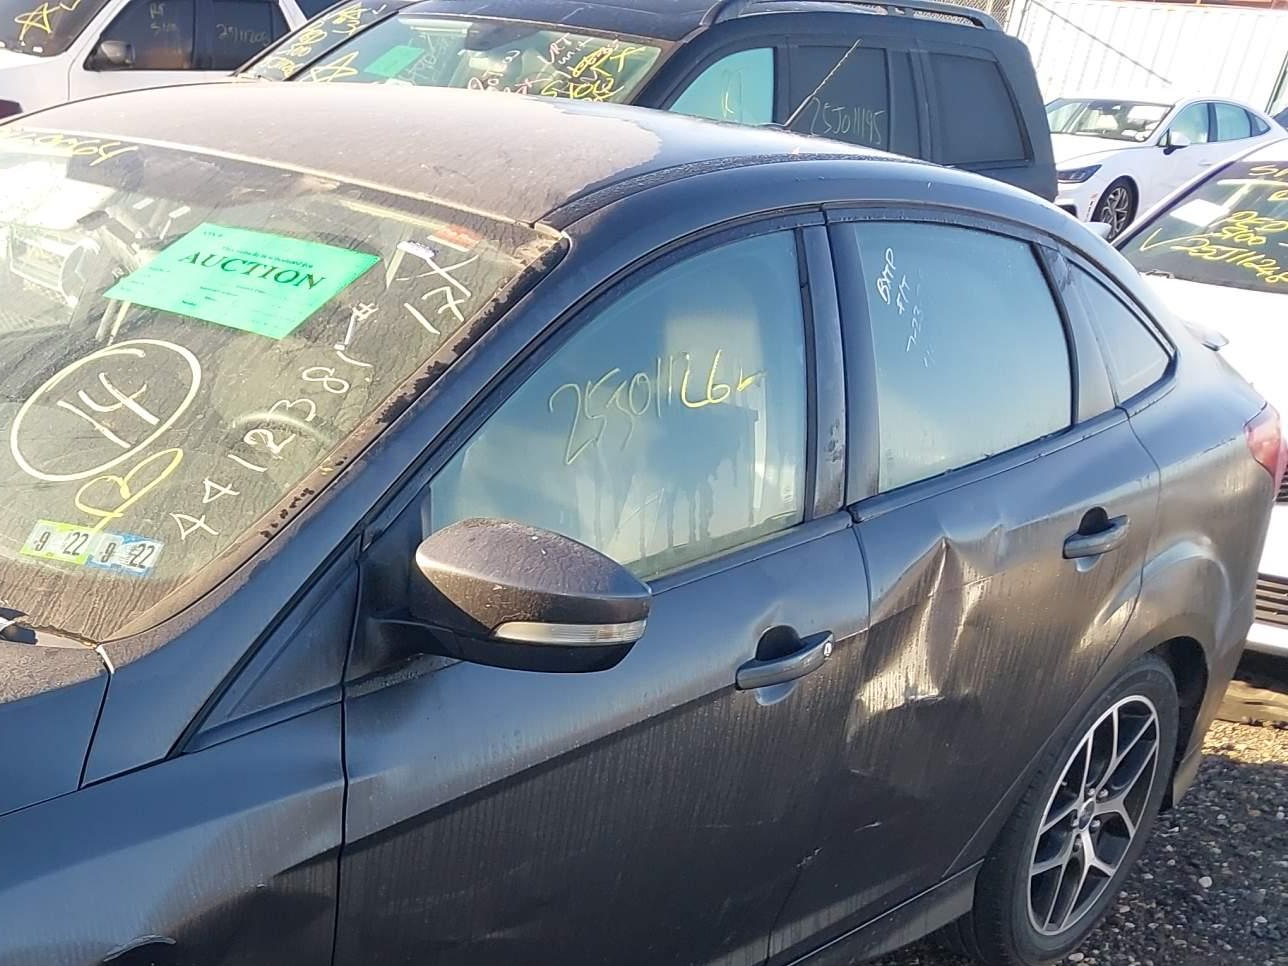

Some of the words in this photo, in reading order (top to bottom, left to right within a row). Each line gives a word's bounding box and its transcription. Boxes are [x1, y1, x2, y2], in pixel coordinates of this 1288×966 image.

[178, 251, 327, 290] AUCTION
[62, 531, 90, 557] 22
[128, 543, 156, 569] 22
